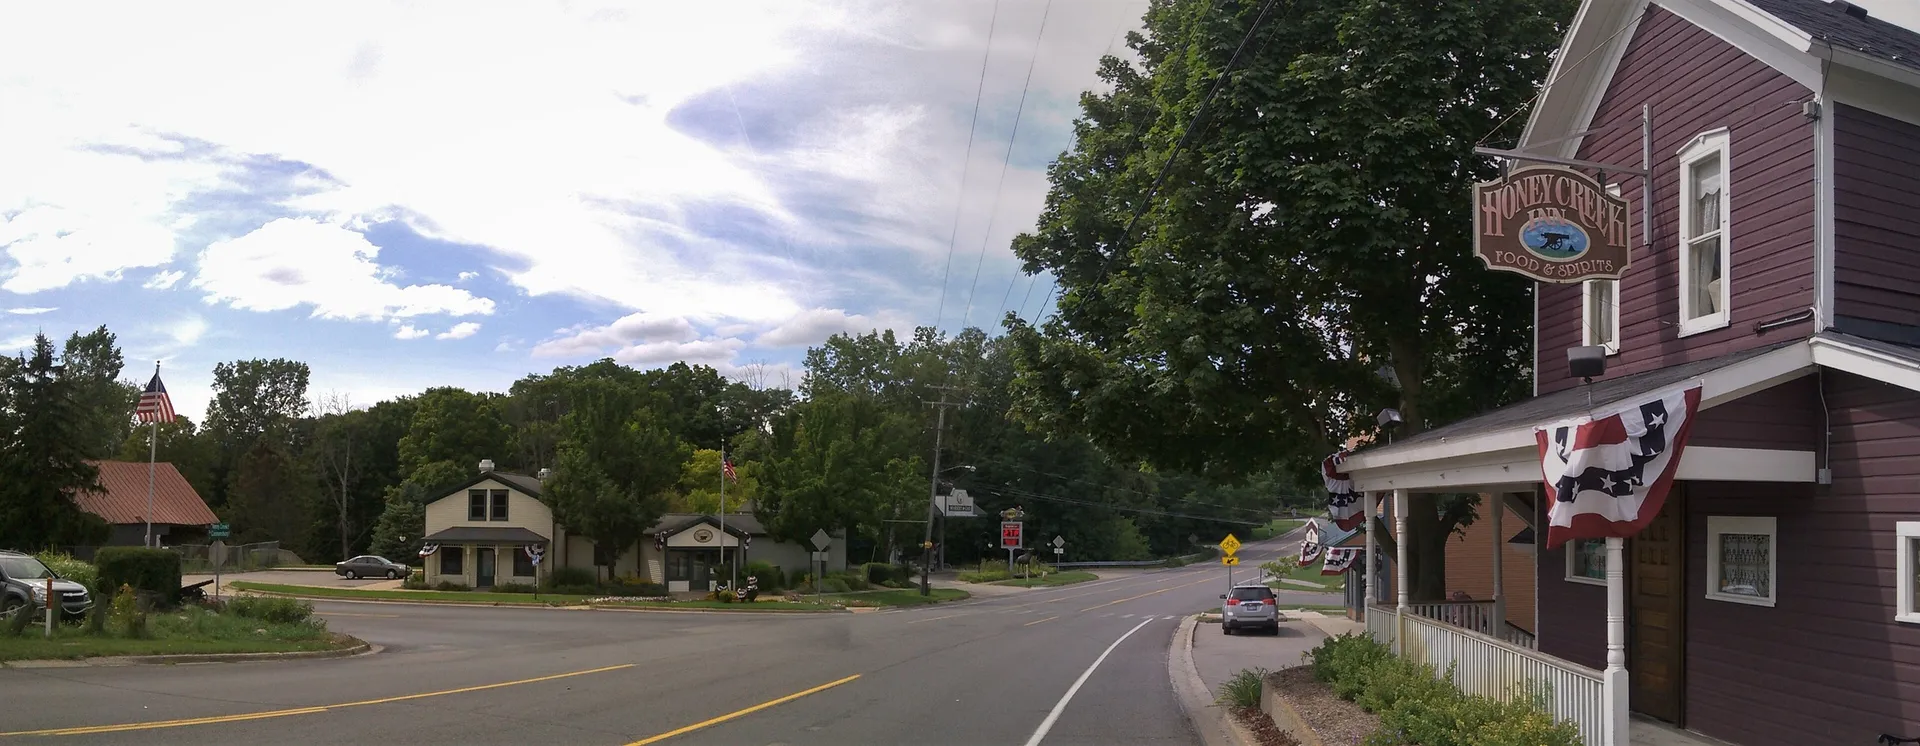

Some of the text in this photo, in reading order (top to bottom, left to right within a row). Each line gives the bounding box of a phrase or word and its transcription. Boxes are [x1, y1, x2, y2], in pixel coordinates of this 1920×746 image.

[1482, 174, 1626, 247] HONEY CREEK
[1527, 207, 1567, 232] INN
[1495, 250, 1614, 277] FOOD & SPIRITS
